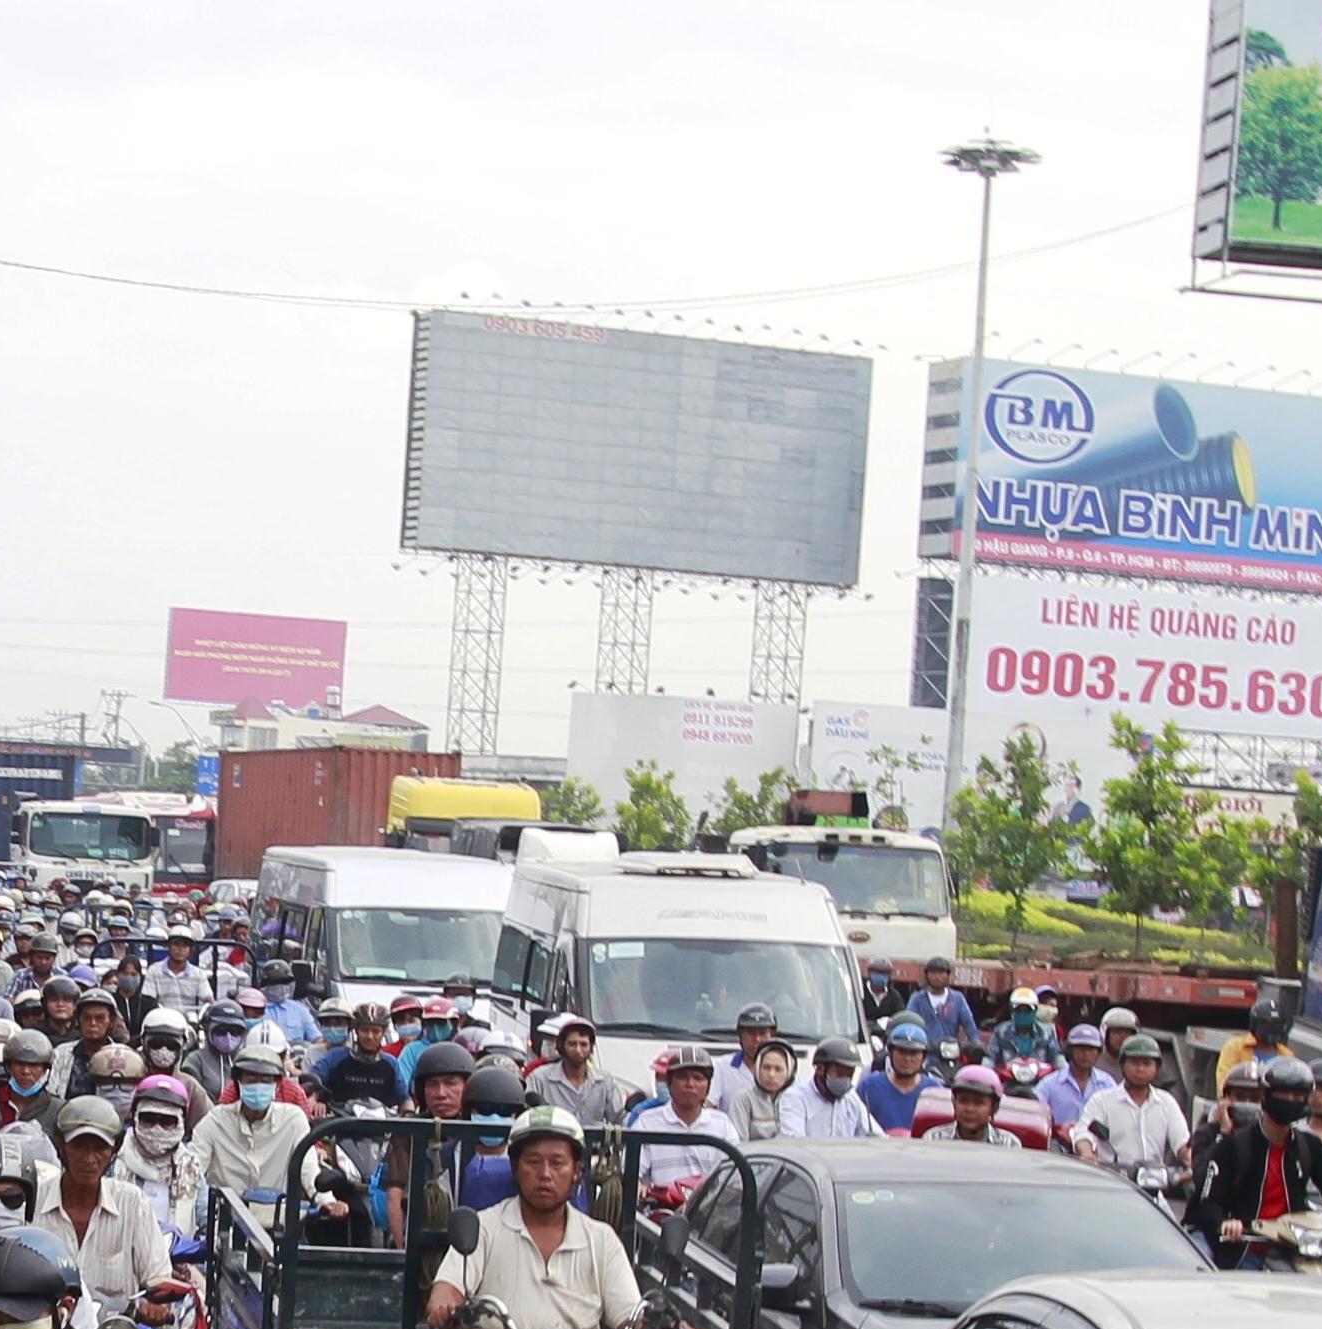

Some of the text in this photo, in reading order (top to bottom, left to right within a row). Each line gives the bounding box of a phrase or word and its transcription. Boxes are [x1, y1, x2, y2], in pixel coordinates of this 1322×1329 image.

[483, 315, 606, 342] 0903 605 459
[1005, 396, 1076, 432] BM
[1006, 429, 1072, 447] PLASCO
[1010, 544, 1048, 559] GIANG
[1041, 594, 1296, 646] LIÊN HỆ QUẢNG CÁO
[826, 715, 851, 726] GAS
